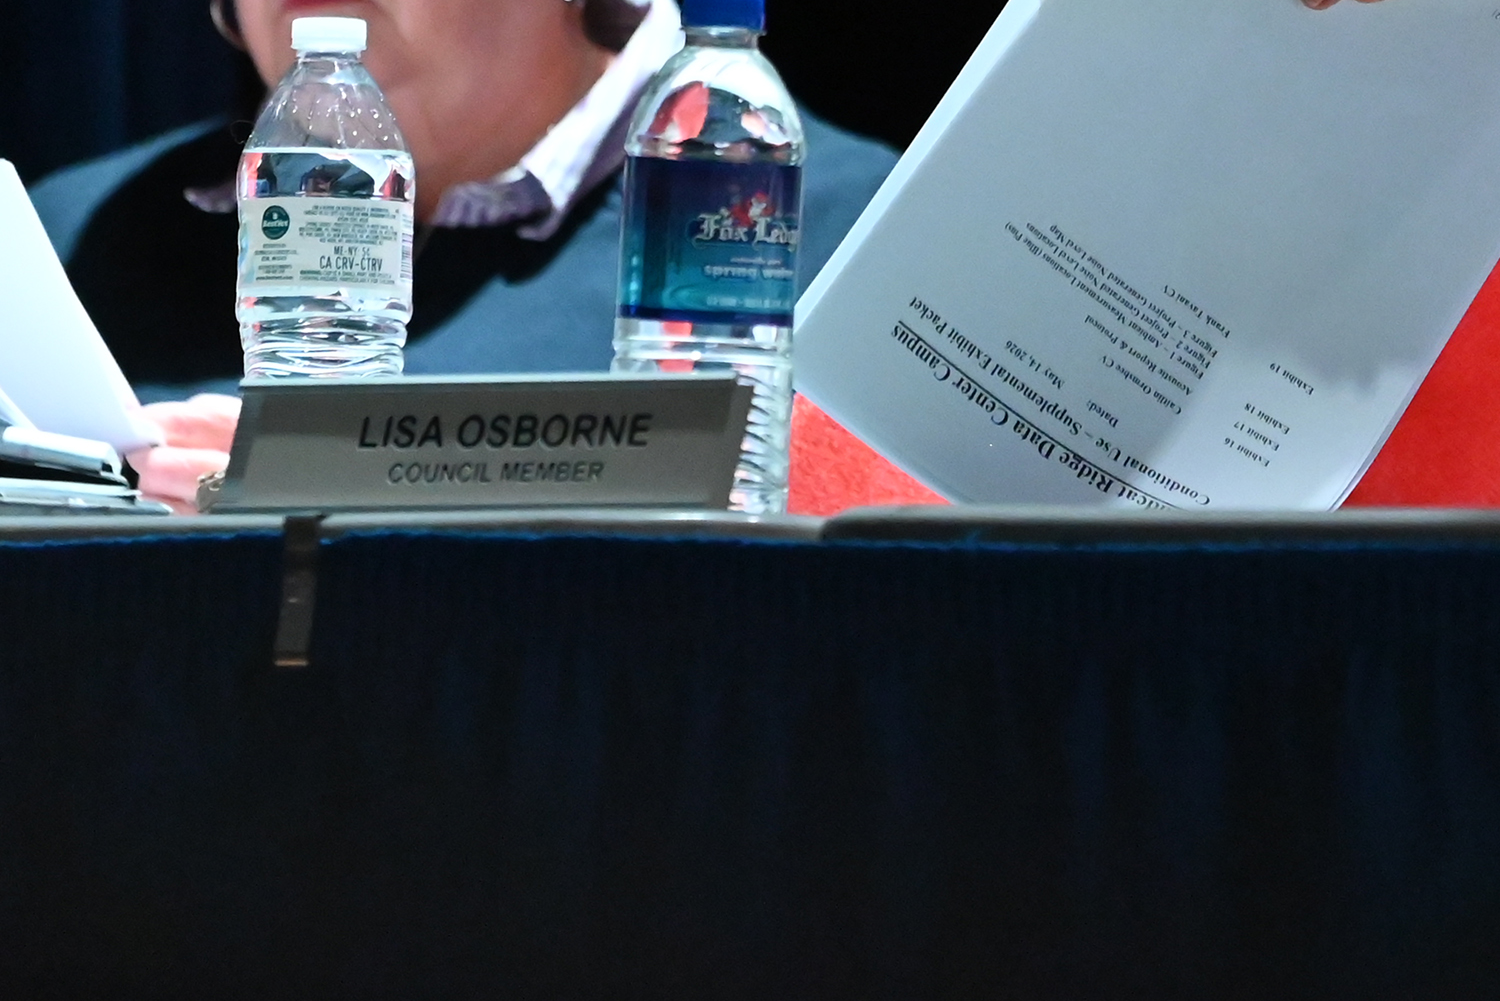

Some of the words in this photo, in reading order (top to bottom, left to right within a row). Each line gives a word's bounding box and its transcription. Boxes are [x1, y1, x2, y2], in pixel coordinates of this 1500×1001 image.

[694, 213, 749, 243] Fox
[1005, 222, 1023, 241] Pins)
[1026, 223, 1059, 254] Locations
[1050, 225, 1064, 243] Map
[1058, 250, 1079, 270] Level
[1065, 239, 1087, 260] Level
[320, 255, 332, 269] CA
[335, 256, 383, 271] CRV-CTRV
[1042, 253, 1077, 285] Locations
[1087, 256, 1105, 276] Noise
[1079, 266, 1097, 287] Noise
[1099, 283, 1140, 317] Generated
[1107, 272, 1147, 306] Generated
[1164, 285, 1176, 297] CV
[1076, 280, 1125, 324] Measurement
[1175, 293, 1203, 318] Tavani
[909, 297, 948, 334] Packet
[1140, 313, 1169, 339] Project
[1148, 302, 1177, 328] Project
[1206, 315, 1230, 338] Frank
[1084, 315, 1119, 344] Protocol
[1128, 320, 1162, 348] Ambient
[891, 325, 951, 381] Campus
[947, 328, 992, 370] Exhibit
[1006, 340, 1027, 361] 2026
[1120, 340, 1128, 350] &
[1184, 345, 1211, 369] Figure
[1191, 334, 1218, 358] Figure
[1029, 356, 1041, 372] 14,
[1102, 355, 1114, 368] CV
[1128, 347, 1157, 372] Report
[1177, 356, 1204, 380] Figure
[1270, 363, 1281, 373] 19
[1044, 368, 1064, 390] May
[1115, 364, 1151, 394] Ormsbee
[1158, 368, 1192, 396] Acoustic
[1282, 370, 1314, 395] Exhibit
[952, 377, 1009, 426] Center
[990, 363, 1082, 435] Supplemental
[1153, 391, 1182, 415] Caitlin
[1244, 403, 1255, 414] 18
[1087, 400, 1119, 428] Dated:
[1257, 410, 1290, 435] Exhibit
[357, 416, 443, 449] LISA
[457, 412, 652, 448] OSBORNE
[1234, 422, 1245, 431] 17
[1013, 420, 1056, 459] Data
[1095, 438, 1121, 462] Use
[1225, 437, 1235, 448] 16
[1247, 427, 1280, 451] Exhibit
[1237, 445, 1270, 467] Exhibit
[388, 462, 493, 484] COUNCIL
[502, 461, 605, 483] MEMBER
[1059, 452, 1114, 493] Ridge
[1123, 456, 1210, 505] Conditional
